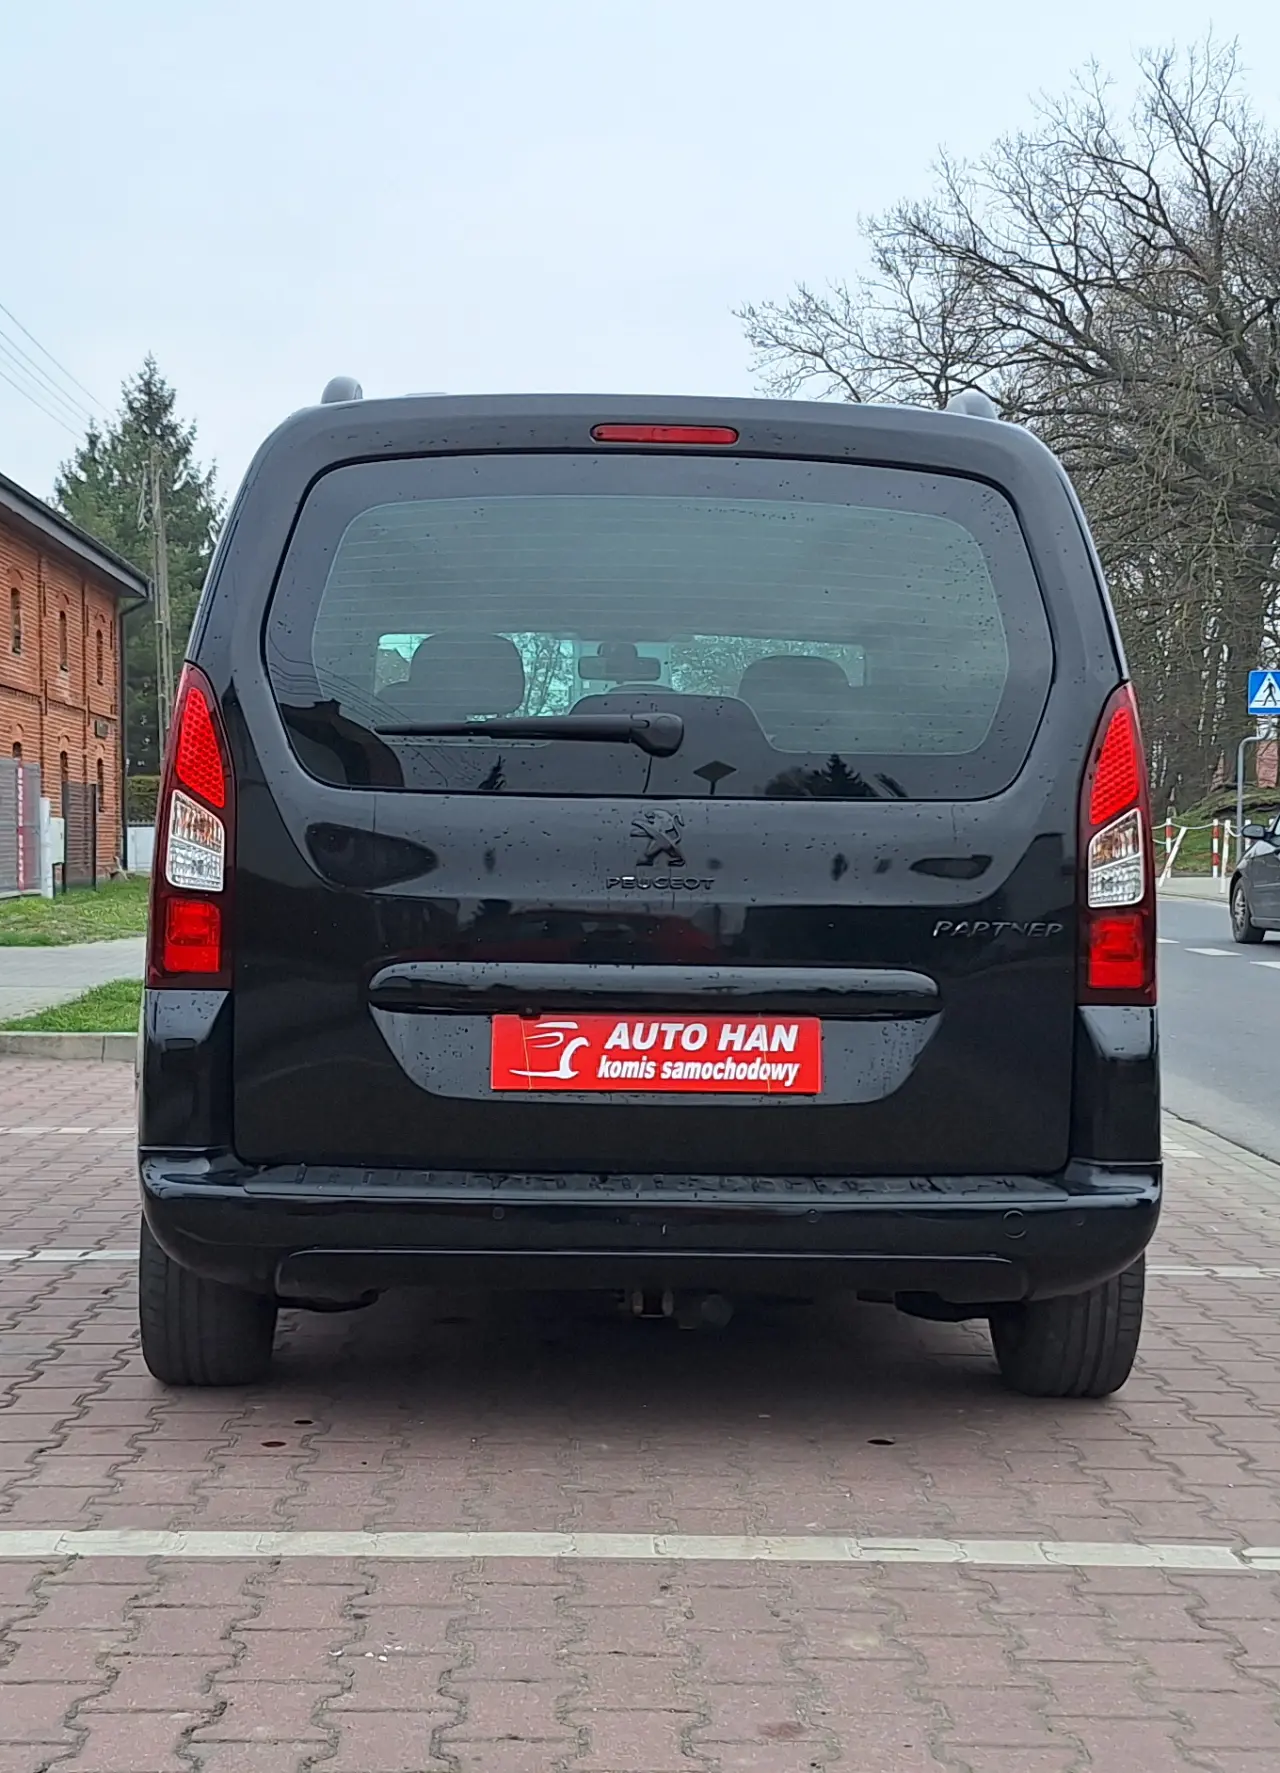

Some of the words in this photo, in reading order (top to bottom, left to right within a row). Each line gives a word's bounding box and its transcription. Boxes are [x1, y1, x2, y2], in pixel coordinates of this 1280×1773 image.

[605, 876, 716, 890] PEUGEOT
[932, 920, 1064, 938] PARTNER
[603, 1022, 708, 1051] AUTO
[717, 1023, 799, 1053] HAN
[597, 1055, 655, 1080] komis
[660, 1057, 800, 1087] samochodowy
